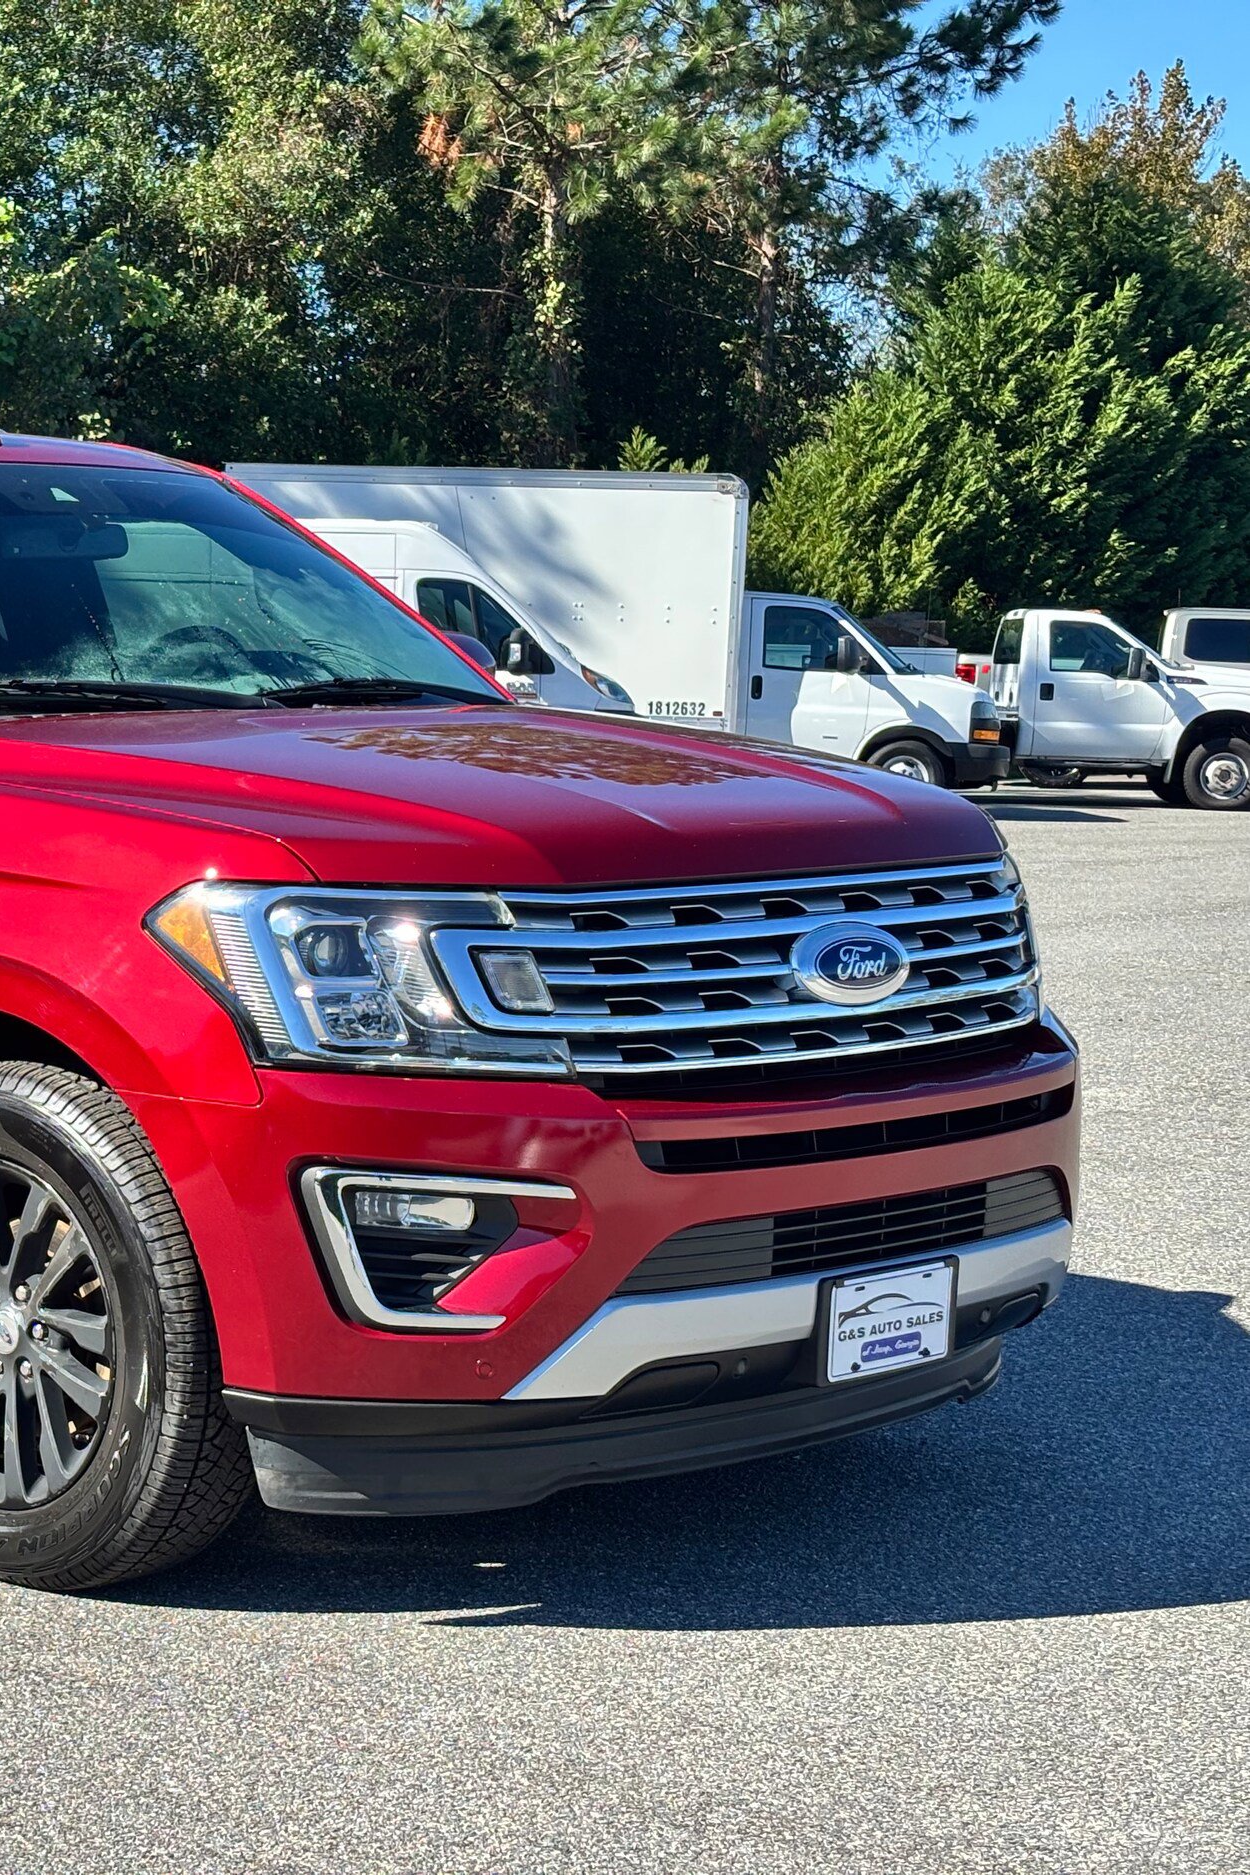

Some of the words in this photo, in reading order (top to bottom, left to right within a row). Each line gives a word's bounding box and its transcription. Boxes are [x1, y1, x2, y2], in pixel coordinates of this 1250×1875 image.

[648, 700, 706, 717] 1812632
[837, 945, 888, 980] Ford
[838, 1326, 865, 1343] G&S
[869, 1319, 902, 1336] AUTO
[906, 1310, 944, 1329] SALES
[17, 1423, 131, 1556] SCORPION
